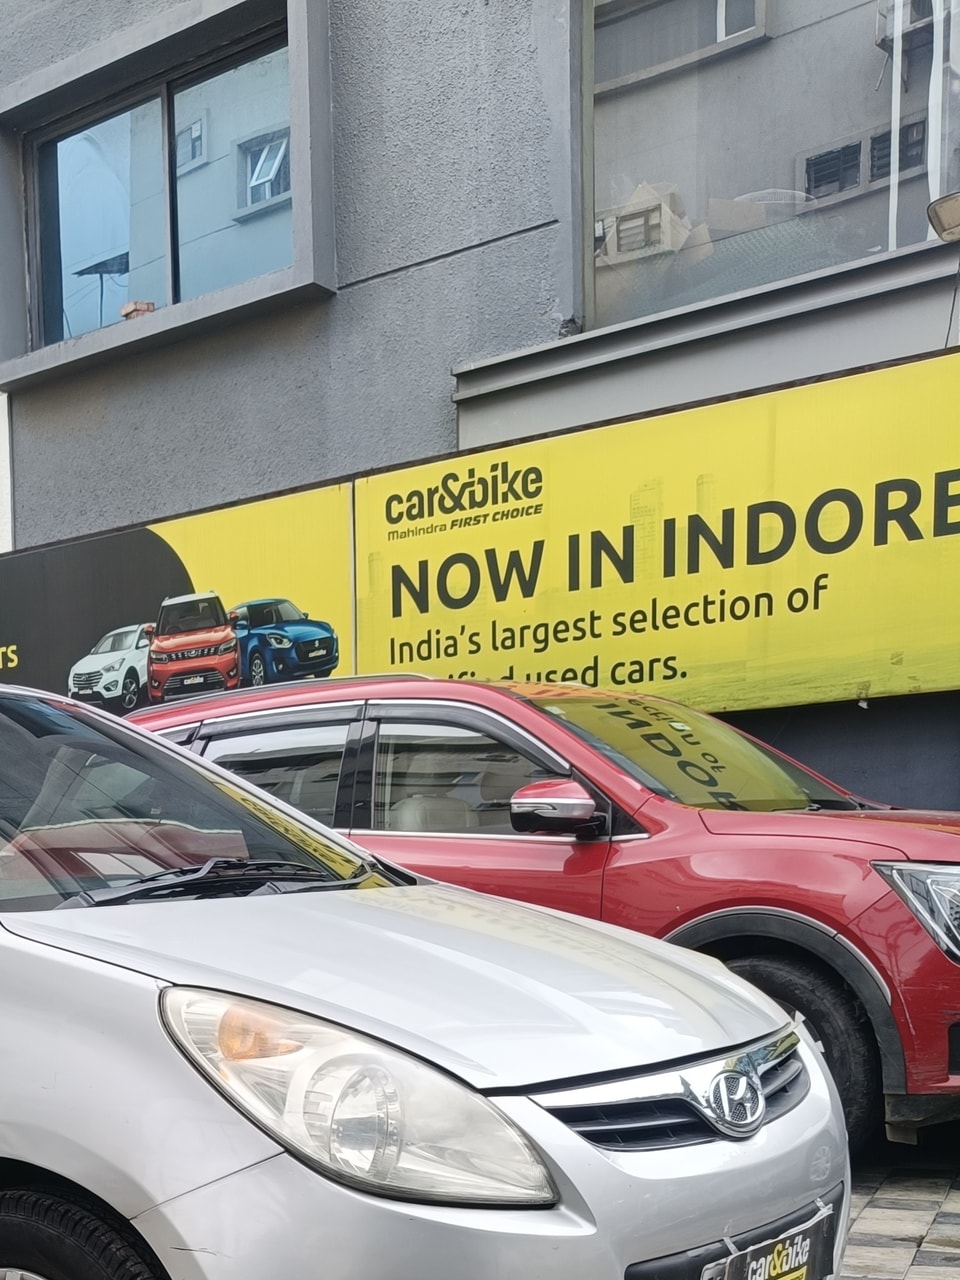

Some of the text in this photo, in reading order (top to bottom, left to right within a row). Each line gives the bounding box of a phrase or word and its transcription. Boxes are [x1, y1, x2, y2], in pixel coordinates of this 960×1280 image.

[385, 461, 543, 525] car&bike
[388, 504, 543, 541] Mahindra FIRST CHOICE
[391, 468, 960, 618] NOW IN INDORE
[491, 610, 602, 653] largest
[612, 589, 773, 637] selection
[787, 573, 829, 613] of
[610, 656, 688, 685] cars.
